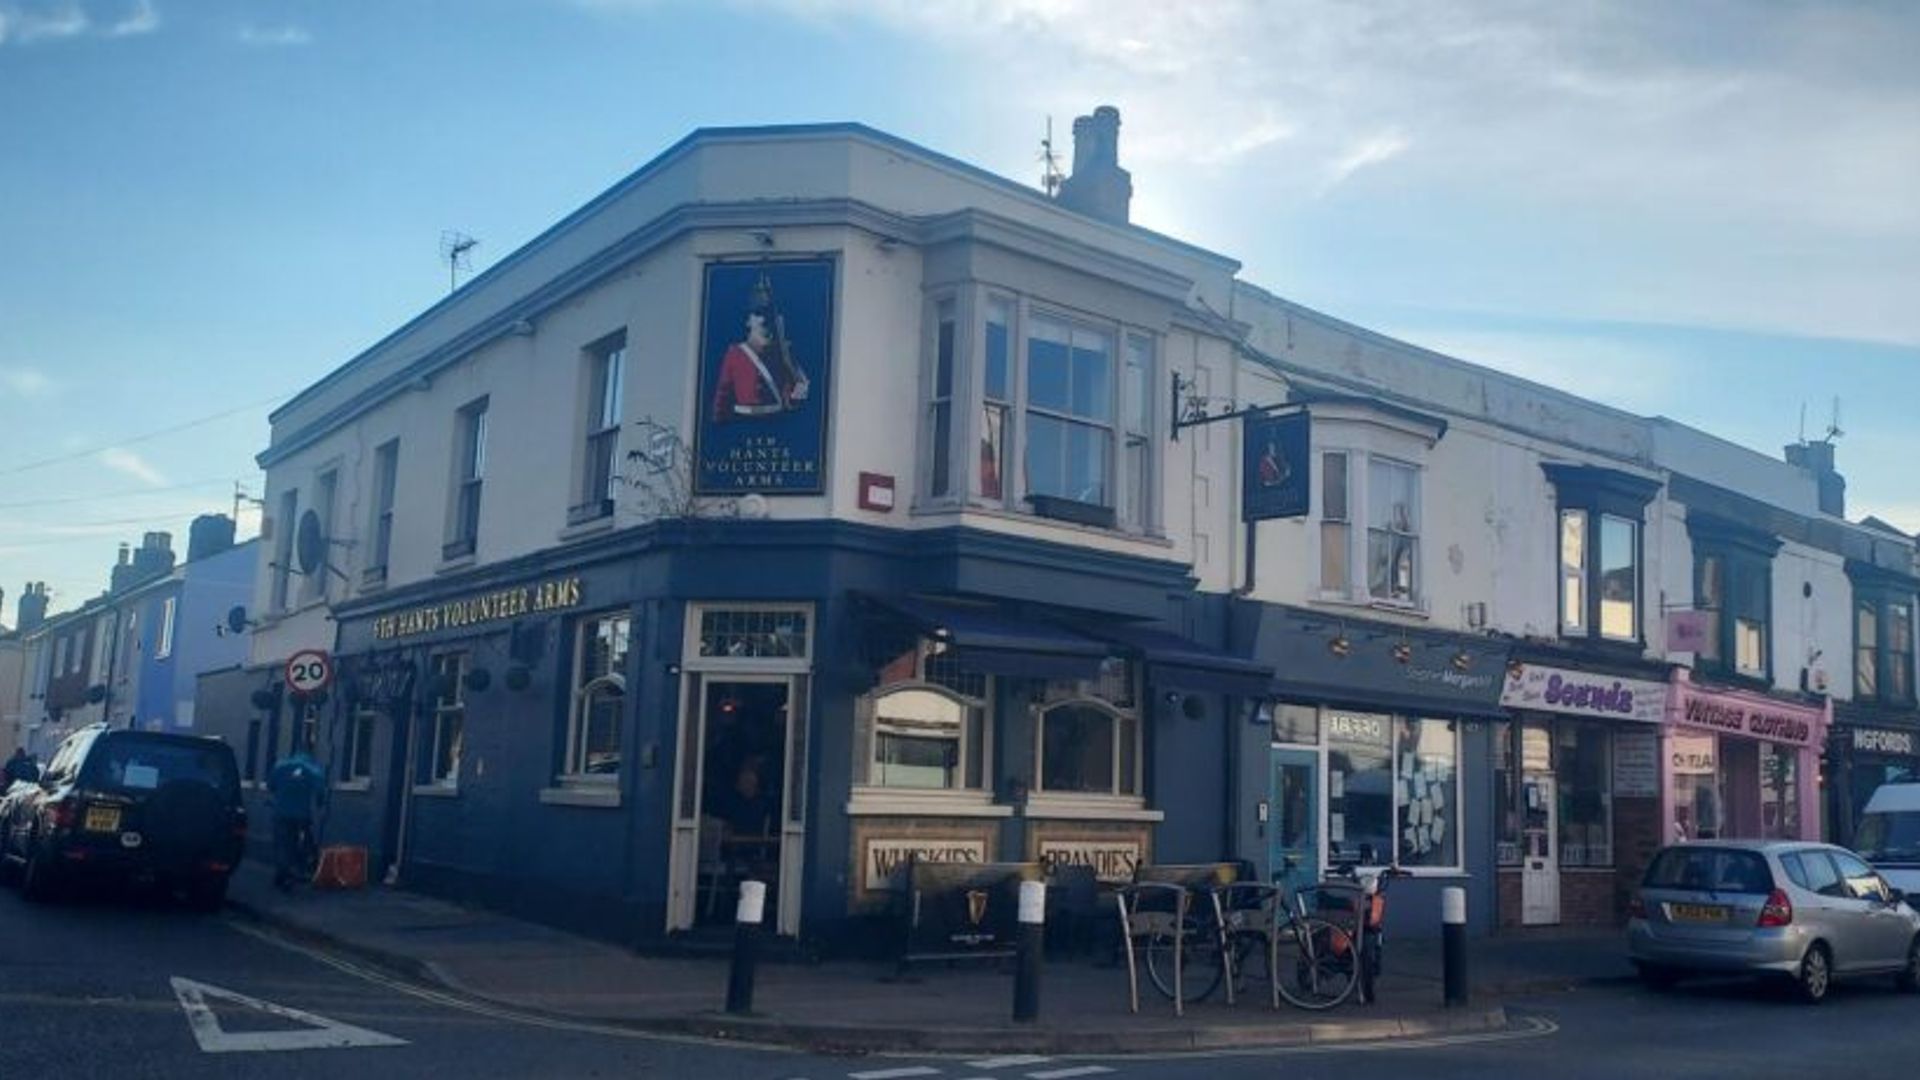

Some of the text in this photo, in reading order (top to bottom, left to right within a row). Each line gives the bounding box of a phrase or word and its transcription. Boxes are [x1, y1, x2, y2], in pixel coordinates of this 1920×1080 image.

[730, 447, 790, 459] HANTS
[705, 461, 814, 473] VOLUNTEER
[735, 475, 784, 486] ARMS
[397, 606, 439, 636] HANTS
[443, 585, 529, 629] VOLUNTEER
[533, 577, 581, 611] ARMS
[292, 661, 324, 682] 20
